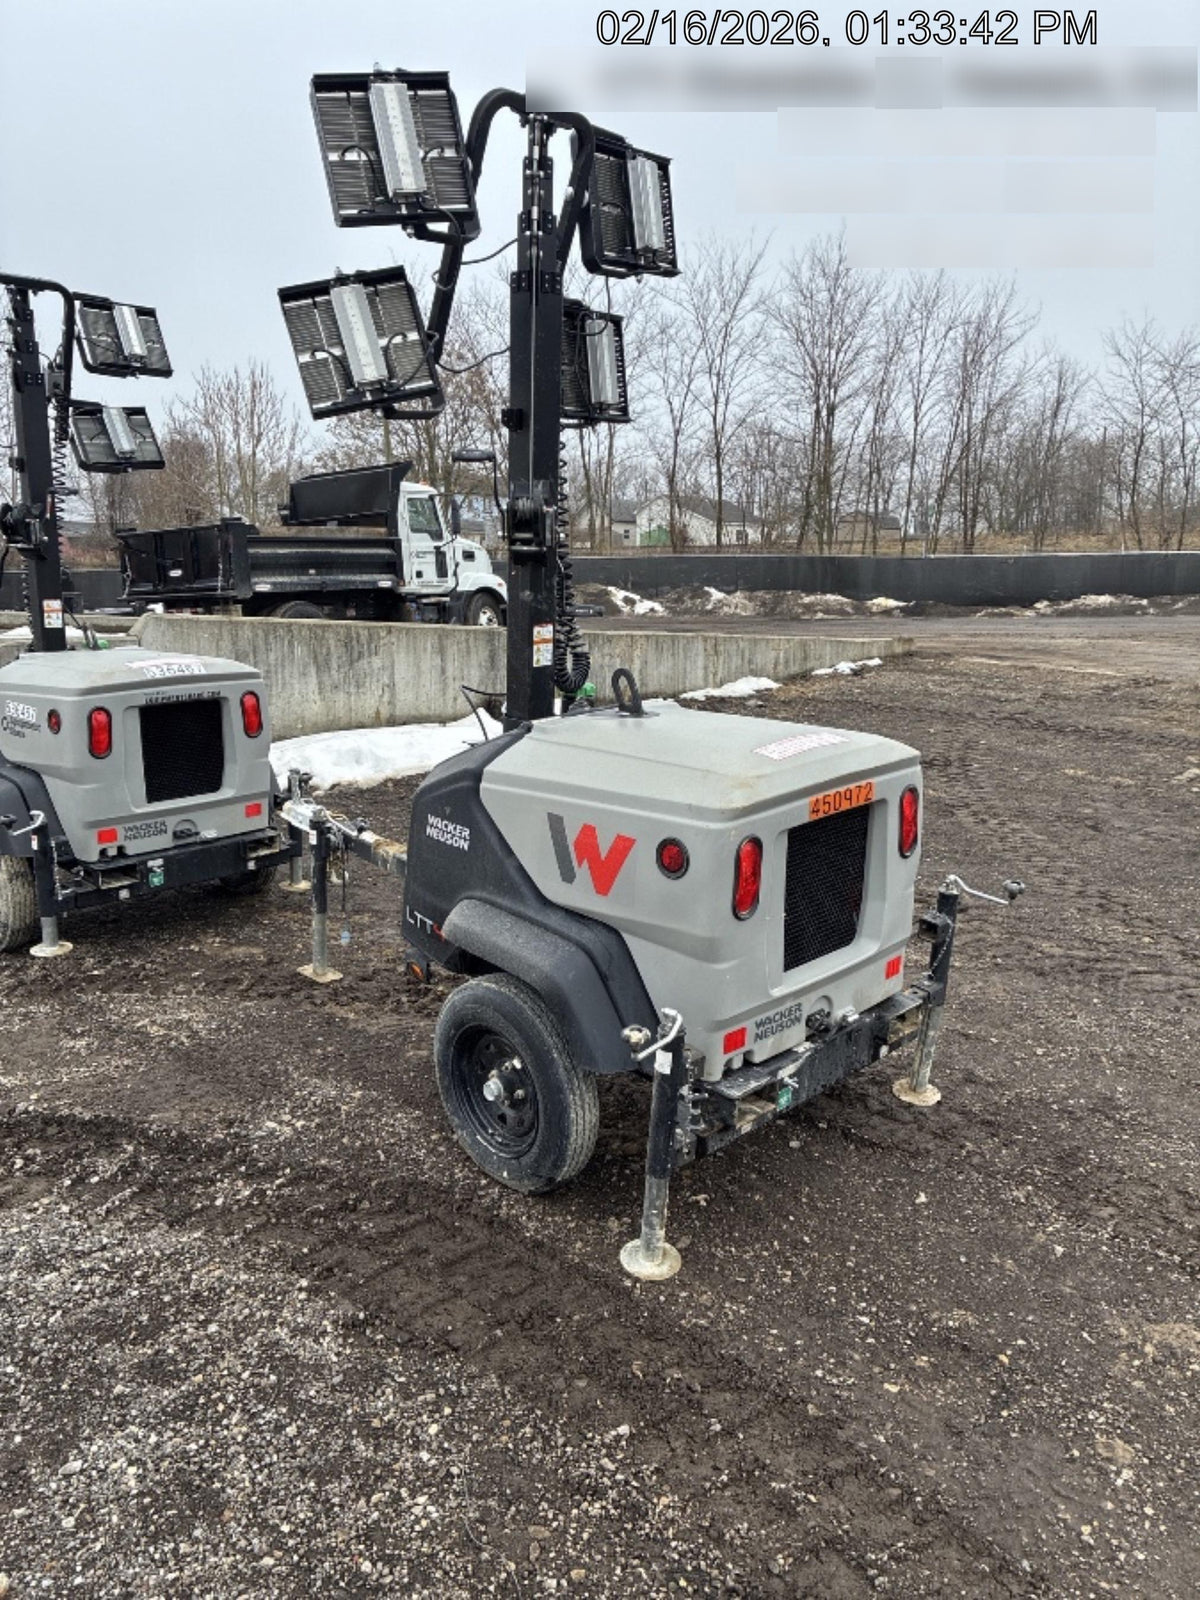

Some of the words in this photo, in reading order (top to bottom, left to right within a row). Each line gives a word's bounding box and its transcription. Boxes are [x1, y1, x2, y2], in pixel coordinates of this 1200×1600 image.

[811, 782, 873, 816] 450972
[123, 820, 168, 834] WACKER
[123, 827, 168, 841] NEUSON
[426, 824, 469, 852] NEUSON
[427, 813, 470, 841] WACKER
[754, 1002, 802, 1030] WACKER
[754, 1013, 802, 1042] NEUSON
